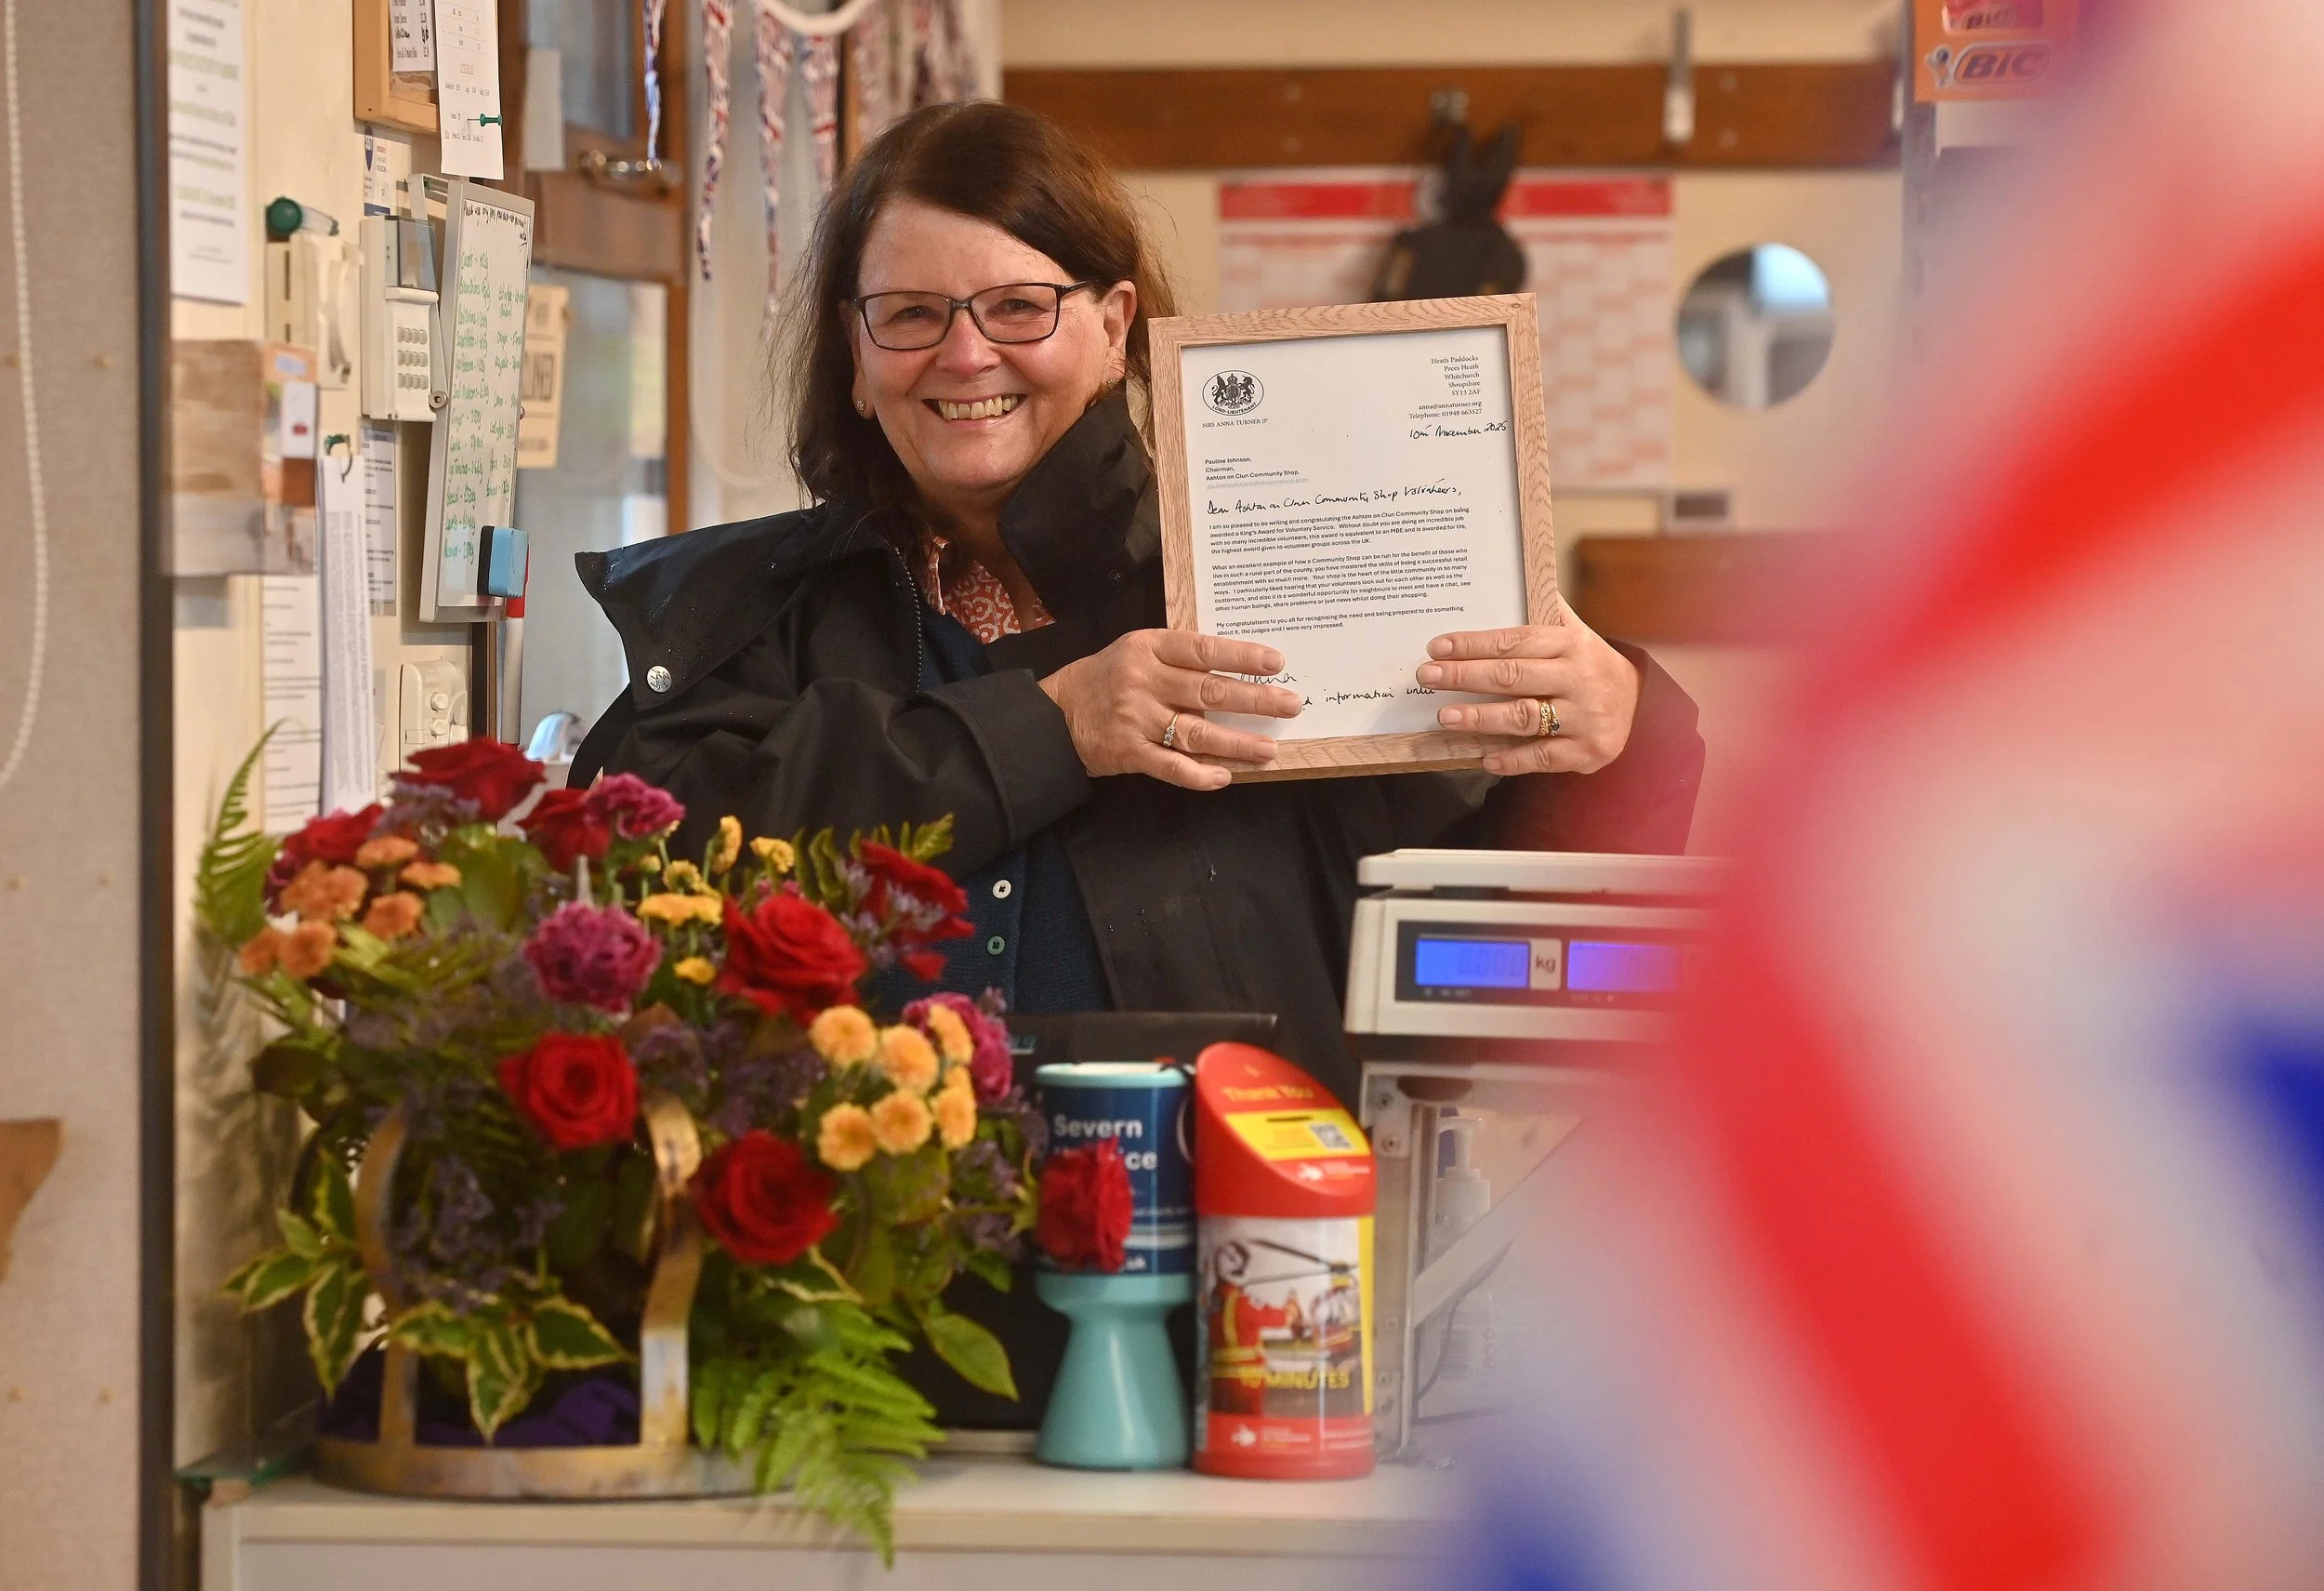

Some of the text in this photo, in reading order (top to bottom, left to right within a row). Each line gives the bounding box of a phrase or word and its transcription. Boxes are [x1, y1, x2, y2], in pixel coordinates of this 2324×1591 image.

[1962, 51, 2042, 79] BIC
[1448, 380, 1481, 389] Shropshire
[1212, 402, 1257, 416] LORD-LIEUTENANT
[1419, 401, 1482, 411] anna@annaturner.org
[1435, 423, 1481, 437] November
[1484, 420, 1508, 431] 2025
[1250, 471, 1282, 479] Community
[1207, 499, 1229, 514] Dear
[1235, 497, 1266, 513] Ashton
[1283, 497, 1310, 508] Clun
[1314, 491, 1368, 506] Community
[1374, 488, 1398, 502] Shop
[1230, 522, 1253, 530] pleased
[1268, 519, 1288, 527] writing
[1301, 515, 1341, 525] congratulating
[1395, 510, 1430, 519] Community
[1429, 508, 1445, 516] Shop
[1285, 525, 1313, 535] Voluntary
[1401, 518, 1418, 526] doing
[1248, 536, 1277, 544] incredible
[1276, 534, 1309, 542] volunteers,
[1344, 529, 1375, 538] equivalent
[1221, 547, 1242, 555] highest
[1261, 544, 1276, 552] given
[1262, 560, 1287, 568] example
[1312, 556, 1346, 565] Community
[1345, 554, 1361, 563] Shop
[1216, 621, 1225, 630] My
[1225, 618, 1270, 629] congratulations
[1304, 614, 1338, 623] recognising
[1375, 610, 1392, 618] being
[1392, 608, 1418, 617] prepared
[1433, 604, 1464, 614] something
[1250, 627, 1270, 635] judges
[1313, 621, 1344, 630] impressed.
[1326, 687, 1394, 703] information
[1535, 954, 1556, 973] kg
[1221, 1085, 1278, 1102] Thank
[1052, 1114, 1143, 1138] Severn
[1265, 1369, 1351, 1390] MINUTES
